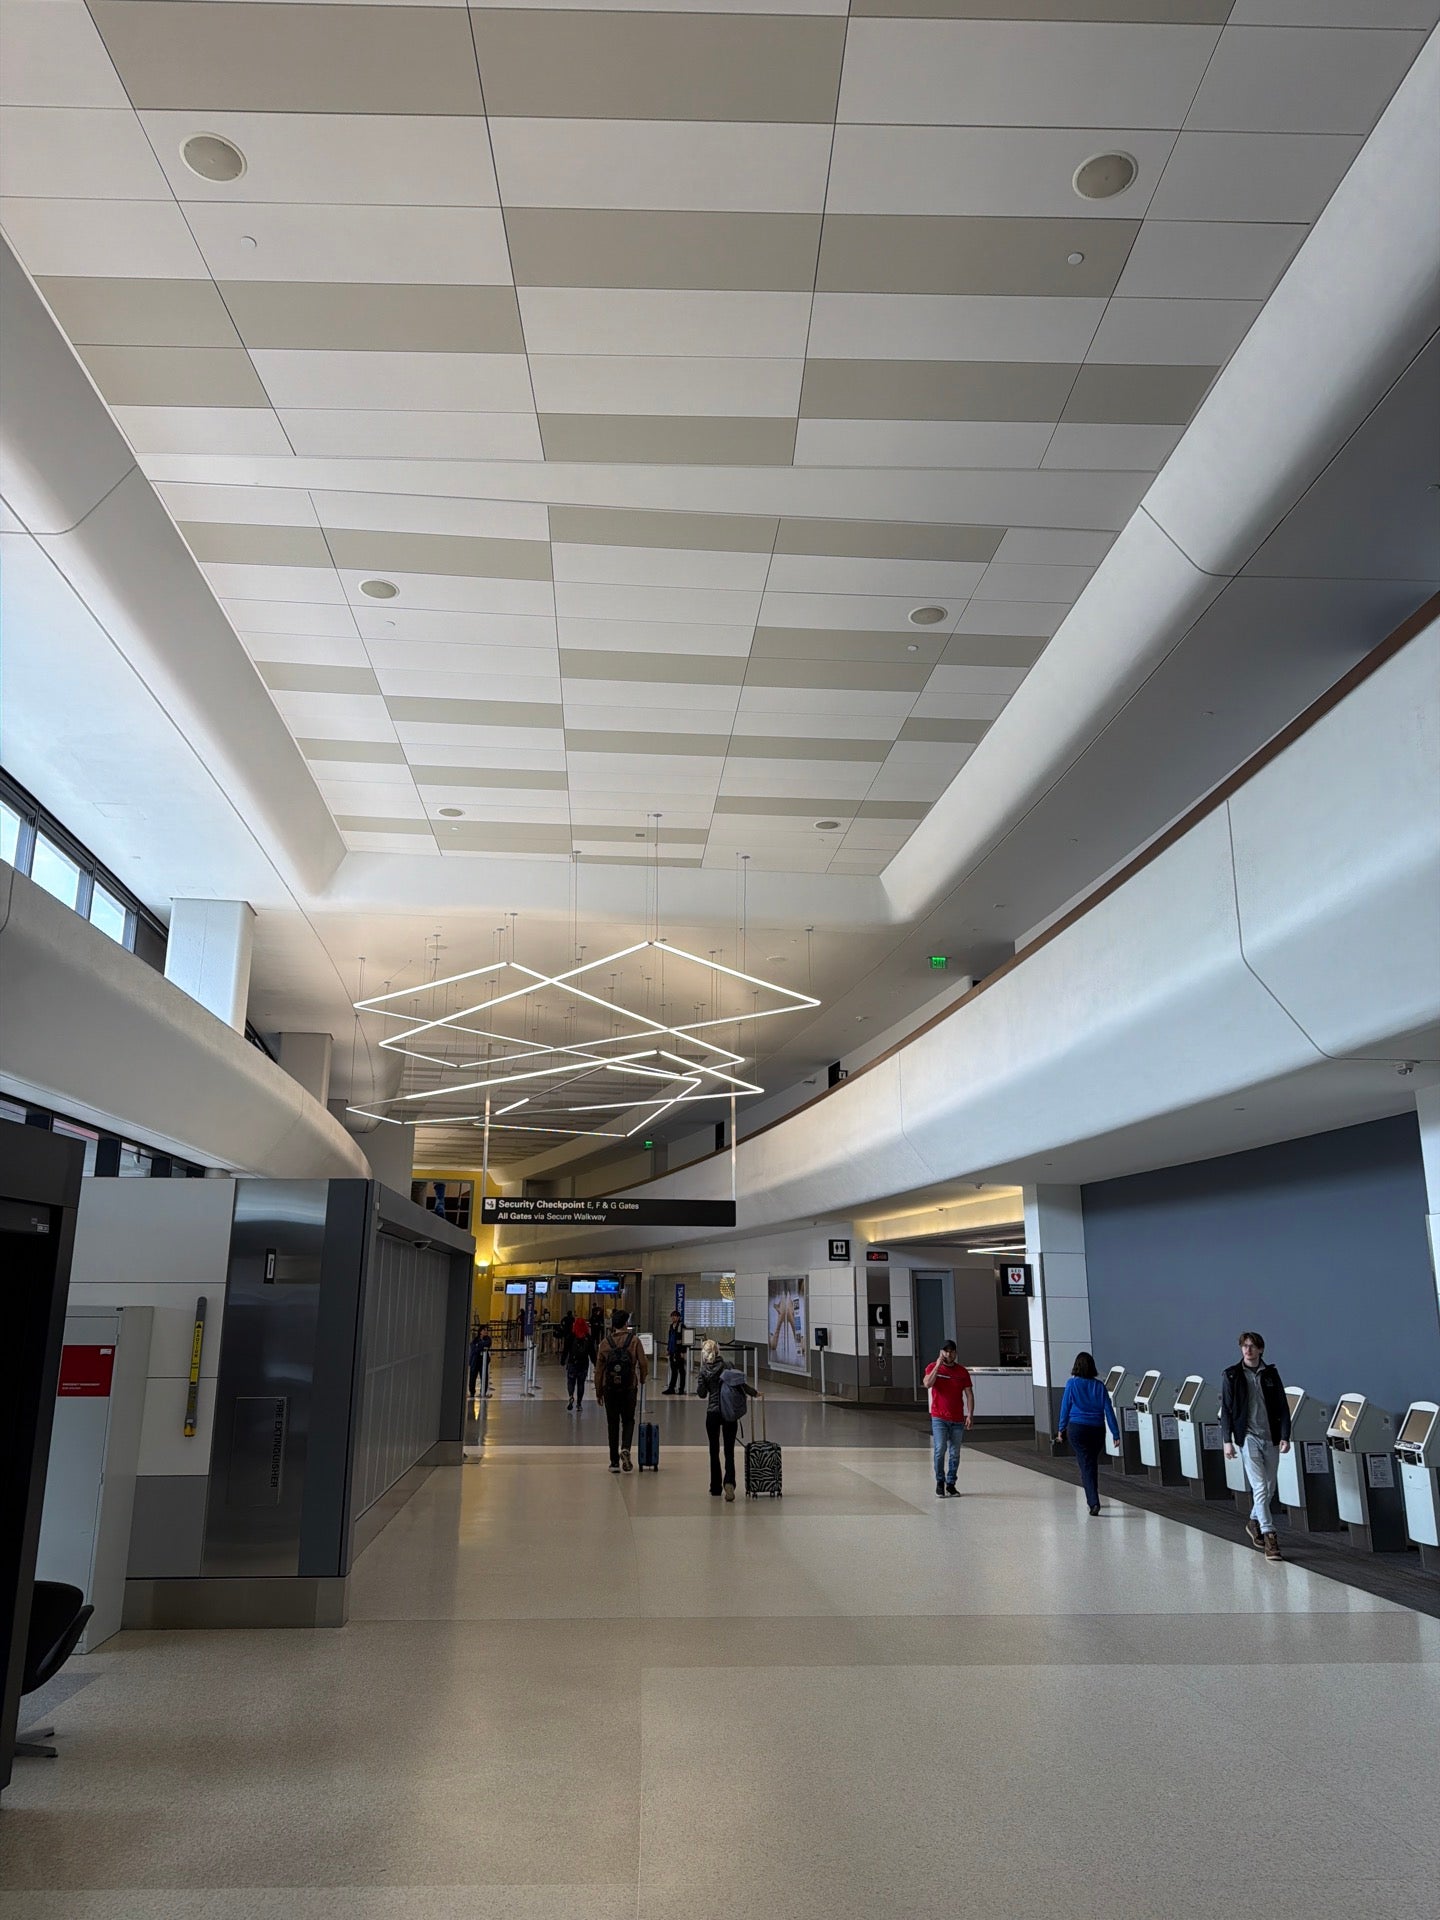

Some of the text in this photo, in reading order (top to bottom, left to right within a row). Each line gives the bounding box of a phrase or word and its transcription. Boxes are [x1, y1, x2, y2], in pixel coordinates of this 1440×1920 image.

[498, 1200, 534, 1210] Security
[536, 1200, 585, 1211] Checkpoint
[587, 1201, 594, 1210] E,
[602, 1201, 609, 1209] &
[618, 1202, 640, 1210] Gates
[497, 1212, 606, 1222] All Gates via Secure Walkway
[270, 1399, 284, 1488] FIRE EXTINGUISHER
